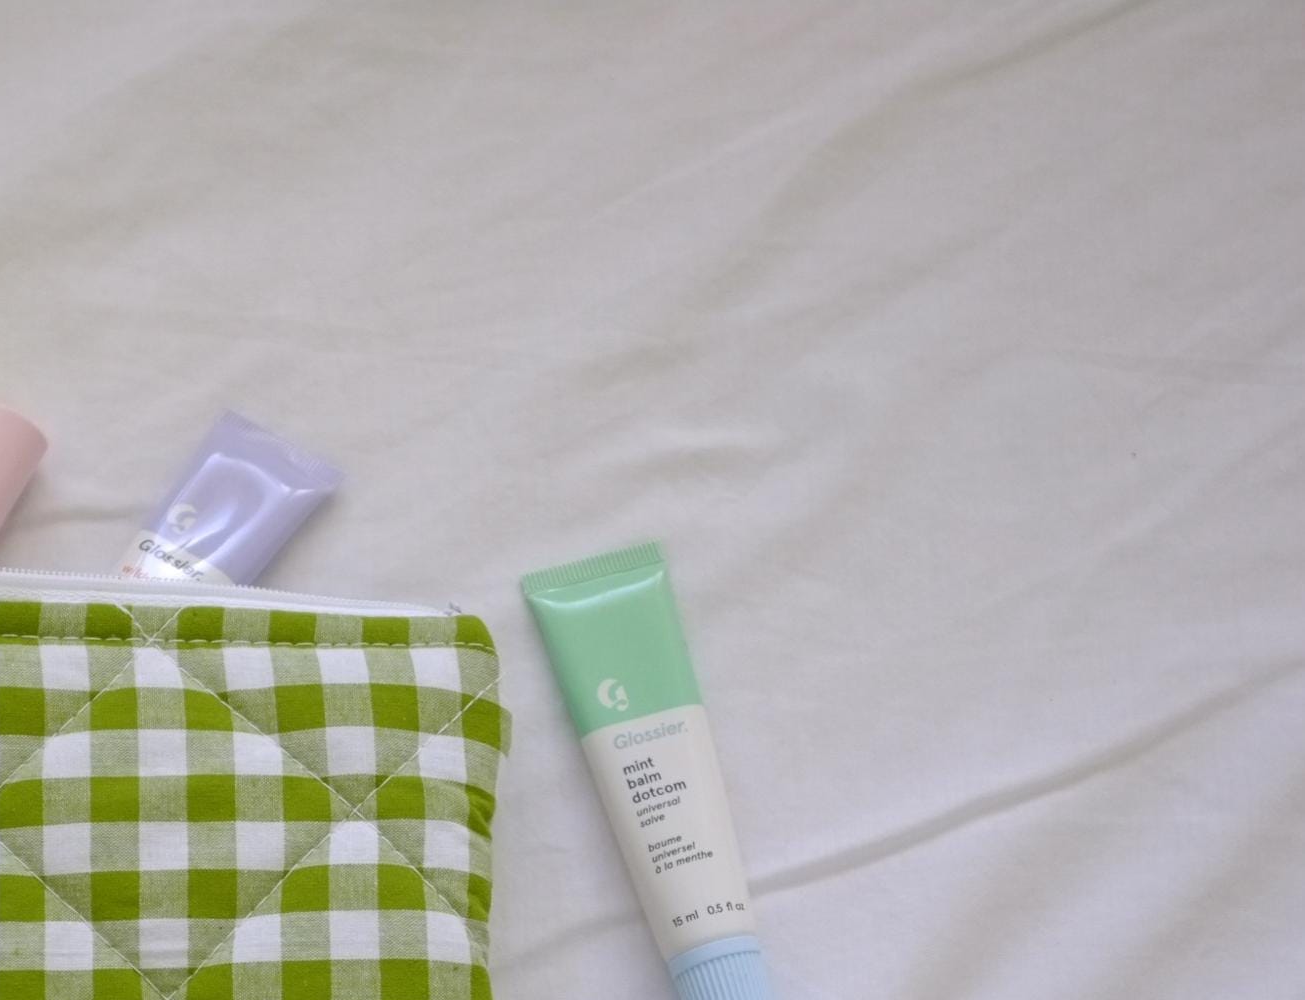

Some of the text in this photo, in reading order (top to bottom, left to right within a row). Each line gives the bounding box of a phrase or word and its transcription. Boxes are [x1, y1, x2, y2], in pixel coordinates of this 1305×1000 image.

[613, 719, 688, 750] Glossier.
[622, 757, 655, 776] mint
[627, 770, 662, 790] balm
[632, 779, 687, 804] dotcom
[636, 796, 681, 817] universal
[640, 812, 665, 828] salve
[648, 834, 682, 853] baume
[651, 842, 696, 864] universel
[655, 849, 713, 875] à la menthe
[672, 915, 683, 928] 15
[685, 910, 699, 922] ml
[707, 903, 723, 915] 0.5
[735, 903, 745, 912] oz
